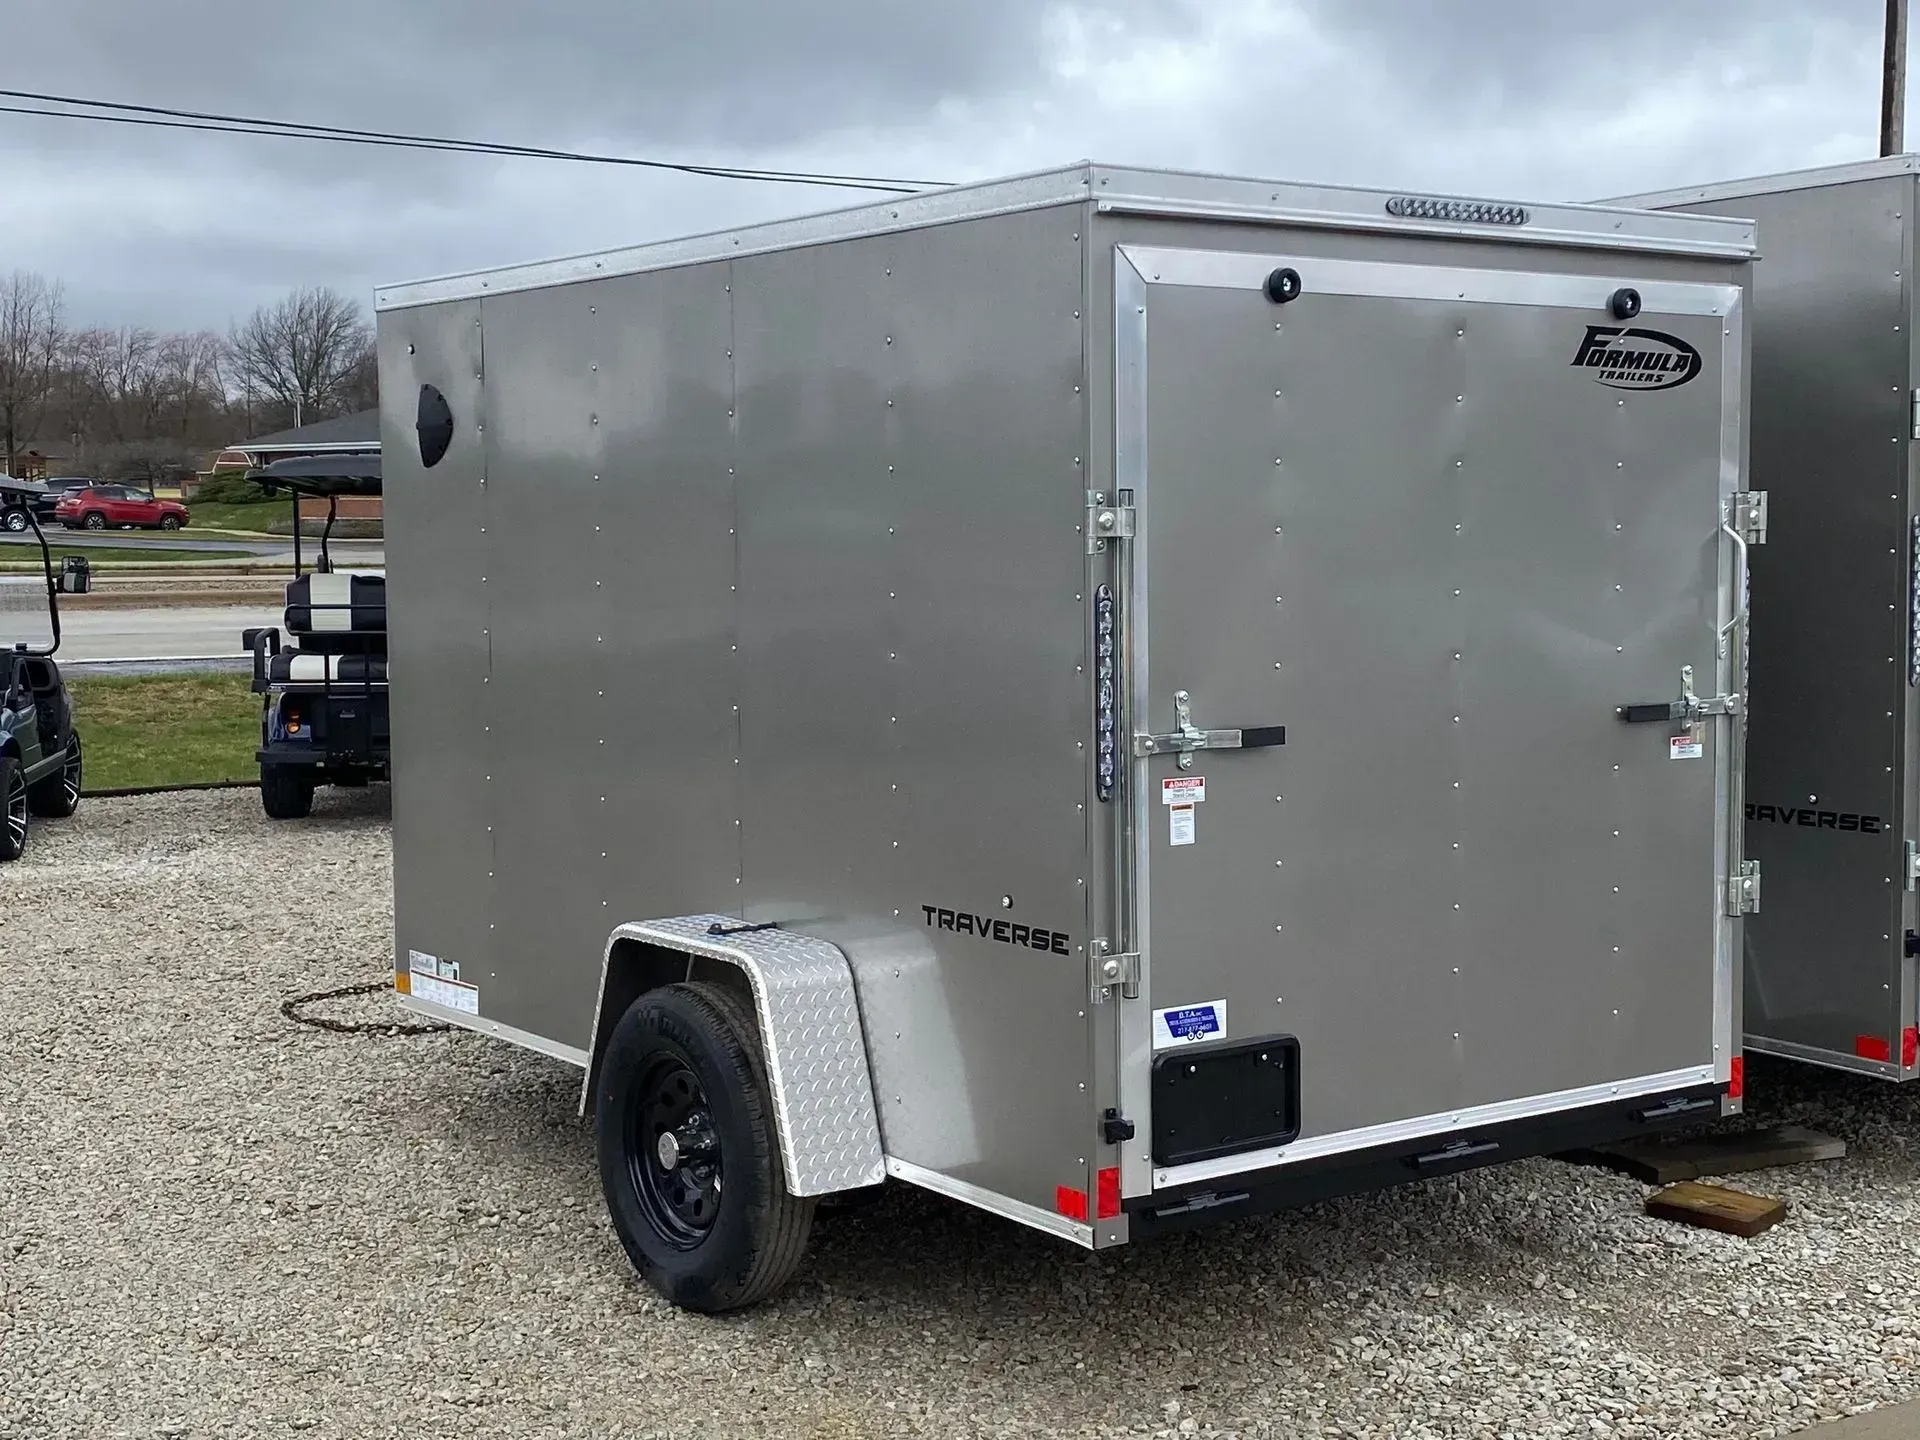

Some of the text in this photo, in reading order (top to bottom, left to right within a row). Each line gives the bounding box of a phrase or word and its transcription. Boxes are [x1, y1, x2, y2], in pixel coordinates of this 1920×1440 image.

[1570, 325, 1692, 373] FORMULA
[1598, 369, 1665, 383] TRAILERS
[1745, 803, 1881, 834] RAVERSE
[921, 904, 1070, 957] TRAVERSE
